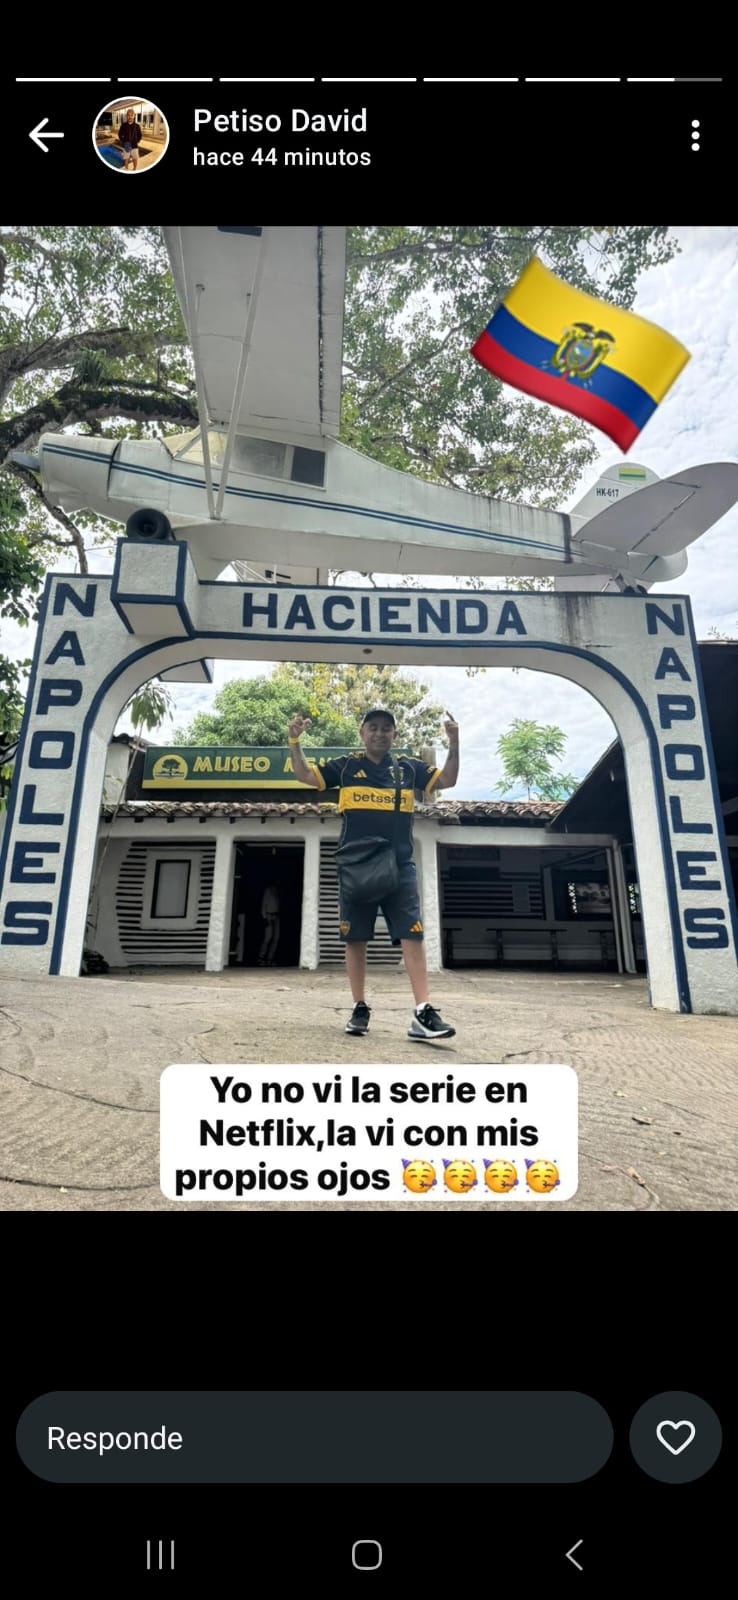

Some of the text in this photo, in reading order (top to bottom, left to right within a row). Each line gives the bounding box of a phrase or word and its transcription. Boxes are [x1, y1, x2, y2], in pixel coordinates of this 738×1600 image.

[596, 488, 619, 498] HK-617
[242, 592, 528, 635] HACIENDA
[1, 583, 97, 945] NAPOLES
[193, 756, 271, 773] MUSEO
[645, 603, 729, 949] NAPOLES
[353, 792, 407, 805] betssn
